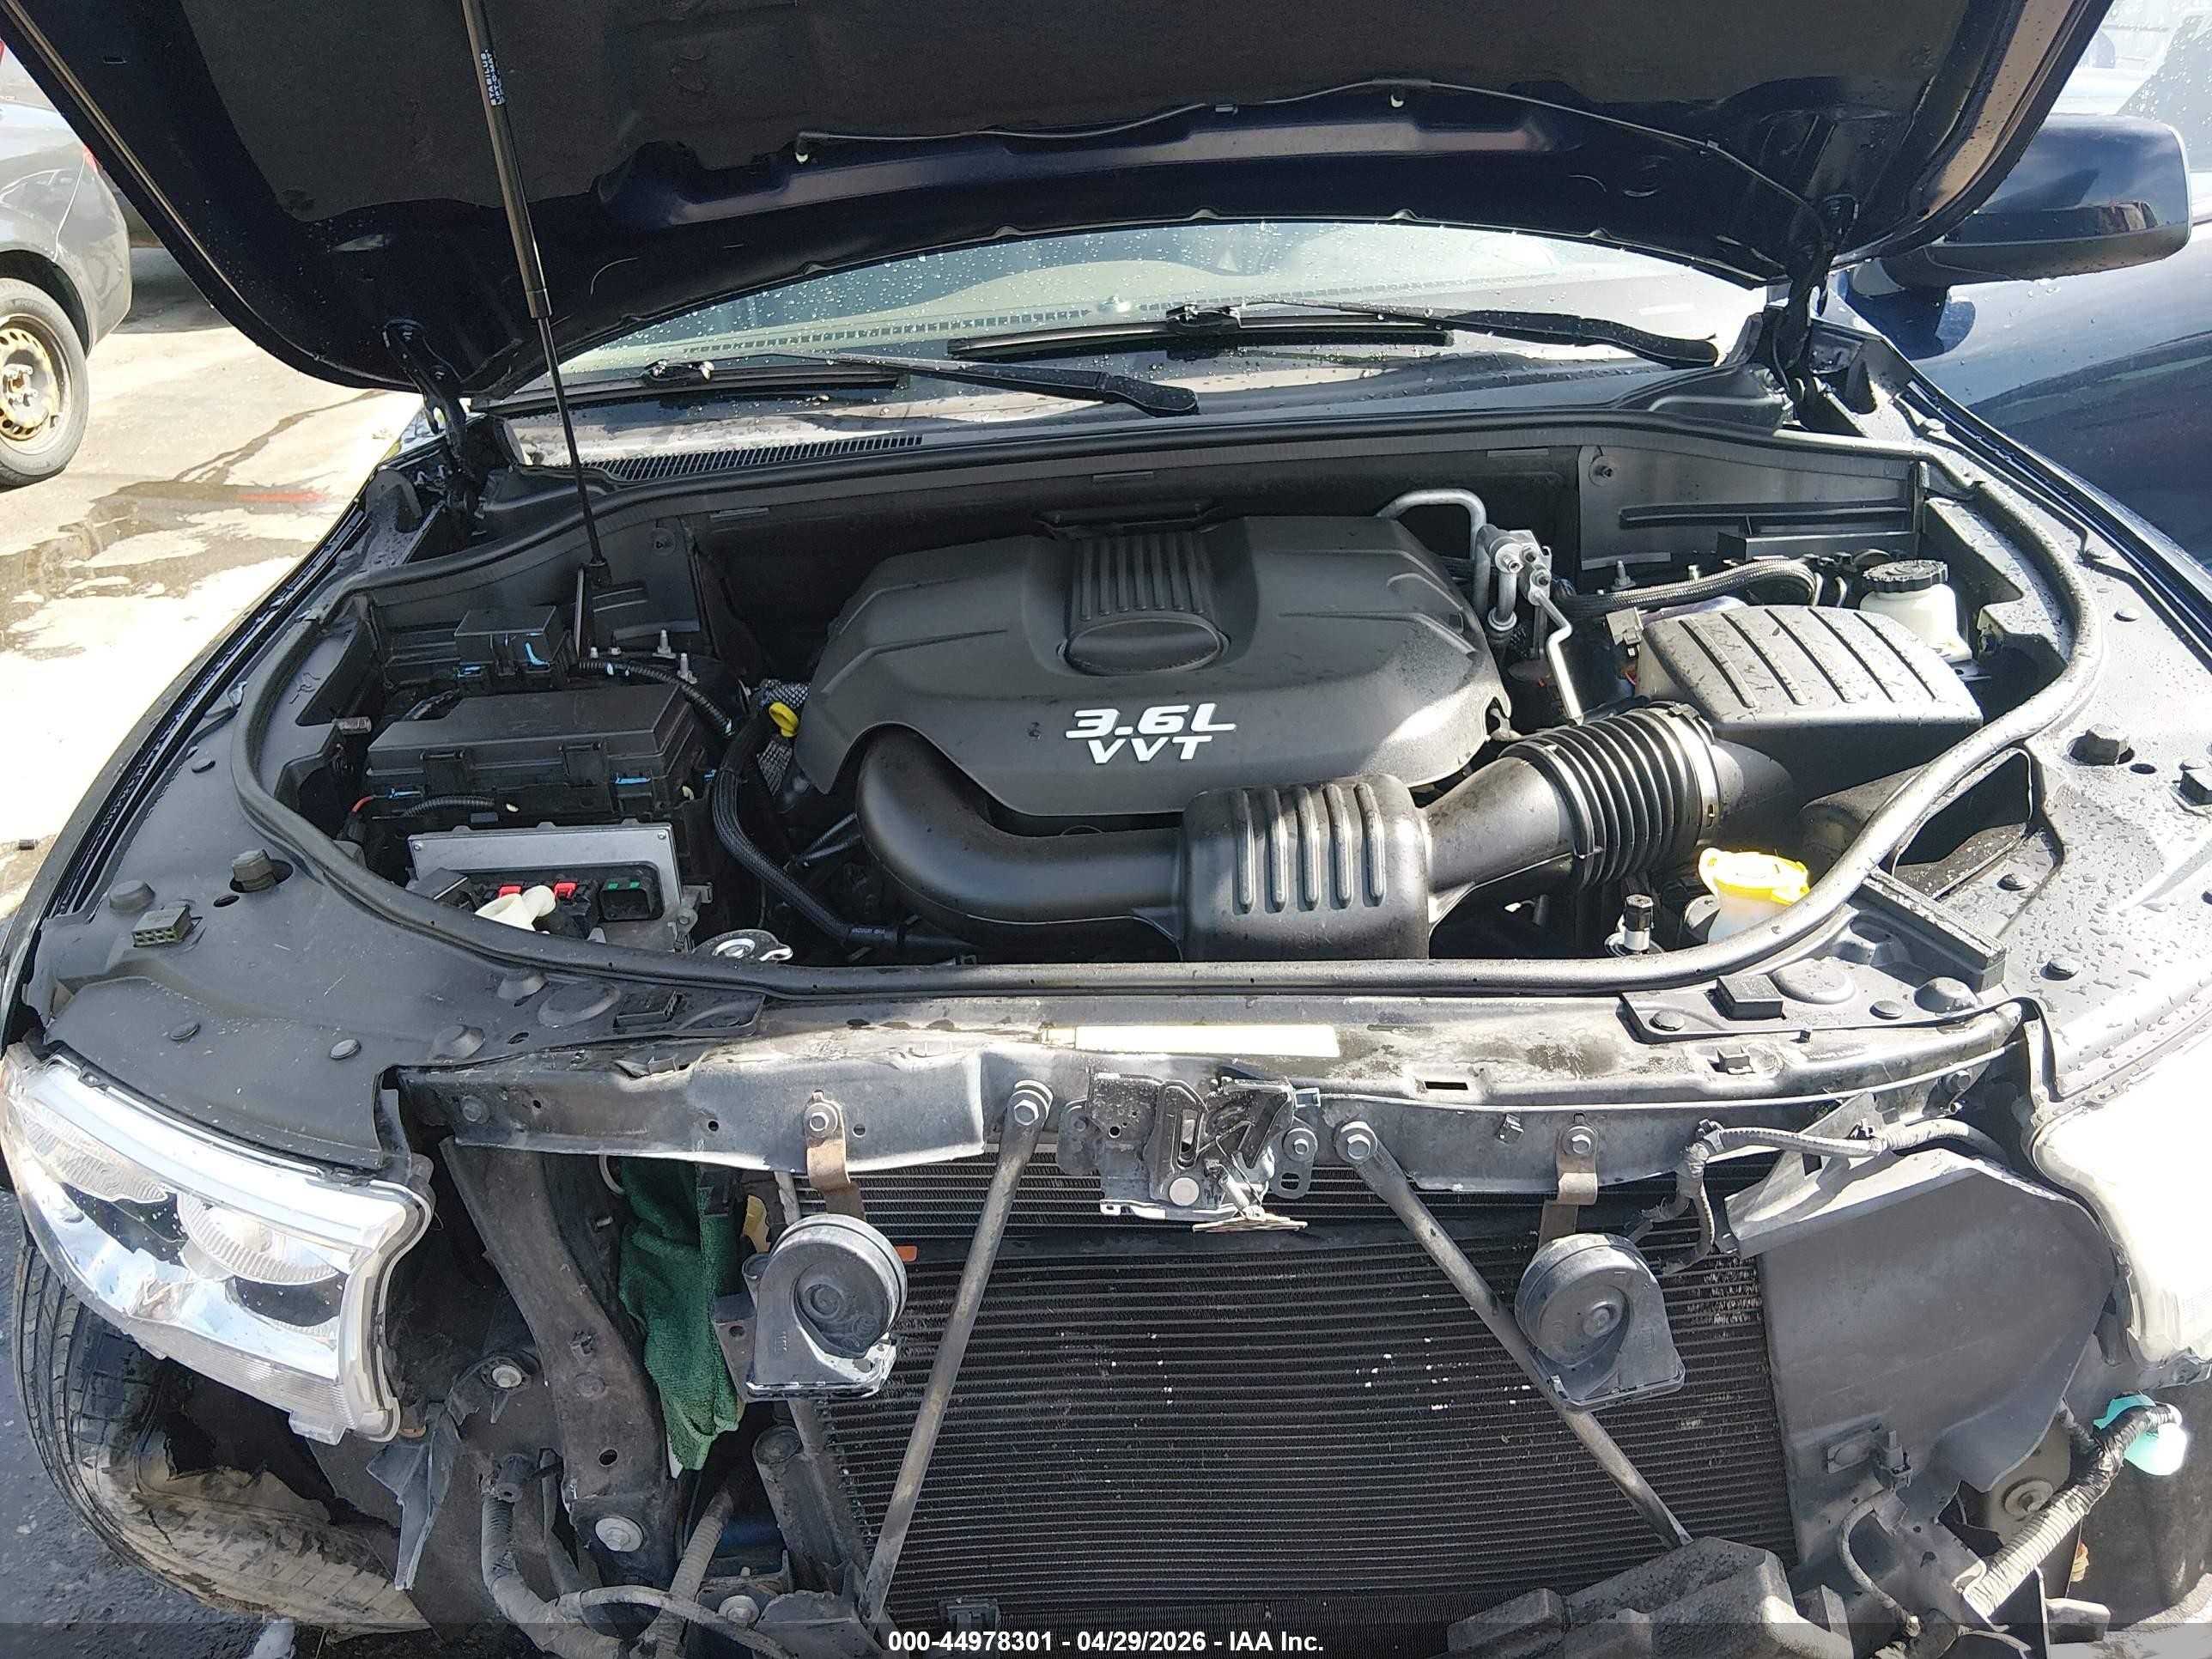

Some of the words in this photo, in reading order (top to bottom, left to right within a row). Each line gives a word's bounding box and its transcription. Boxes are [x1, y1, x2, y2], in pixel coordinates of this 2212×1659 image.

[480, 52, 497, 106] STABILUS
[1065, 702, 1237, 738] 3.6L
[1087, 735, 1212, 764] VVT
